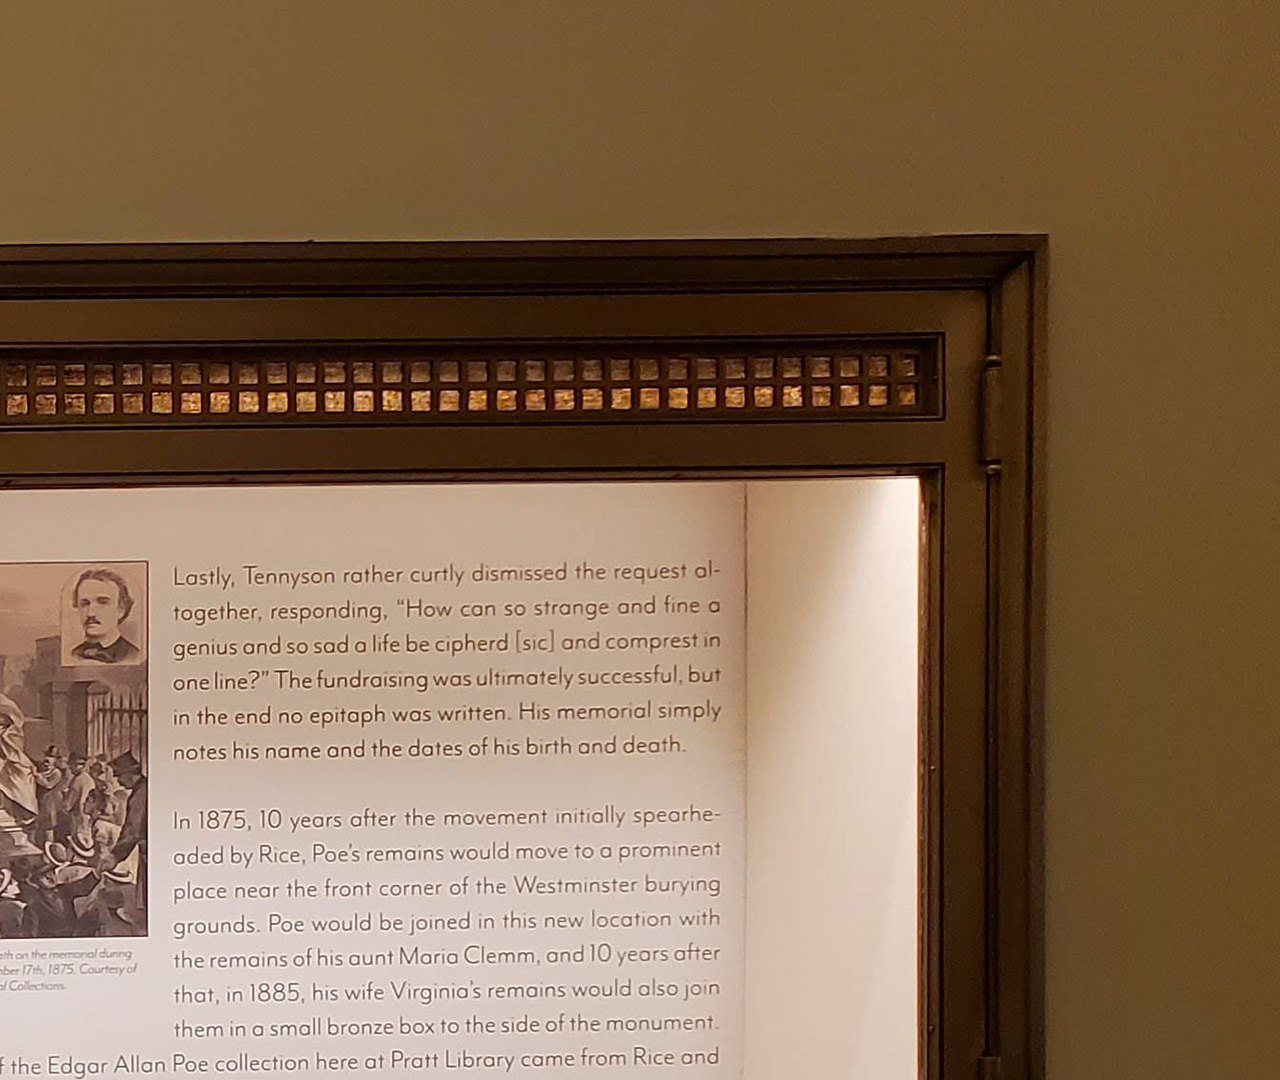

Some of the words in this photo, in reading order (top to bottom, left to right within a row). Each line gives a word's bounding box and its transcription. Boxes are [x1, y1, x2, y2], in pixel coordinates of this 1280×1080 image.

[173, 565, 236, 592] Lastly,
[241, 565, 336, 591] Tennyson
[343, 563, 404, 584] rather
[409, 563, 466, 588] curtly
[471, 561, 568, 583] dismissed
[574, 560, 607, 581] the
[613, 563, 688, 586] request
[694, 559, 721, 579] al-
[173, 810, 191, 831] In
[198, 809, 253, 833] 1875,
[259, 808, 283, 830] 10
[289, 815, 343, 834] years
[349, 807, 397, 828] after
[403, 807, 436, 827] the
[443, 809, 548, 827] movement
[555, 804, 626, 829] initially
[632, 803, 722, 829] spearhe-
[79, 963, 125, 977] Courtesy
[126, 963, 138, 974] of
